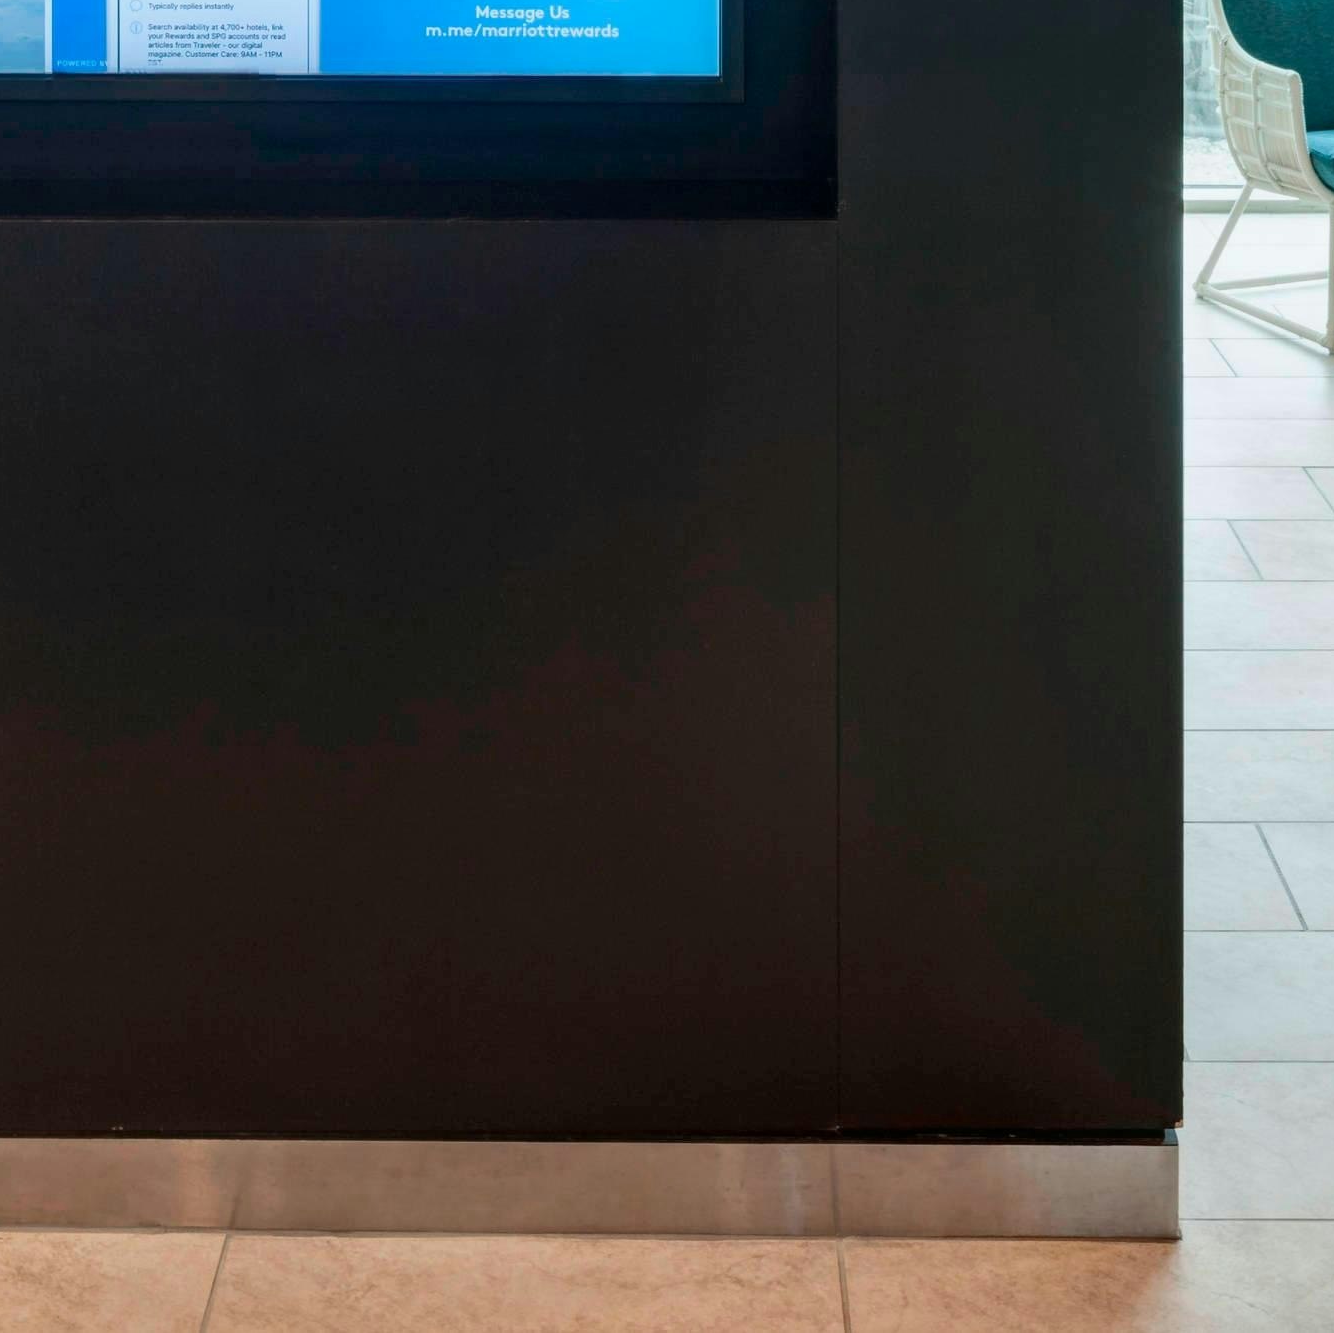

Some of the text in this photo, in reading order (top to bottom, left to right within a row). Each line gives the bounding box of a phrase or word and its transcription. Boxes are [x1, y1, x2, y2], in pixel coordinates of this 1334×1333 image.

[148, 2, 234, 10] Typically replies instantly
[475, 5, 570, 24] Message Us
[426, 24, 619, 38] m.me/marriottrewards
